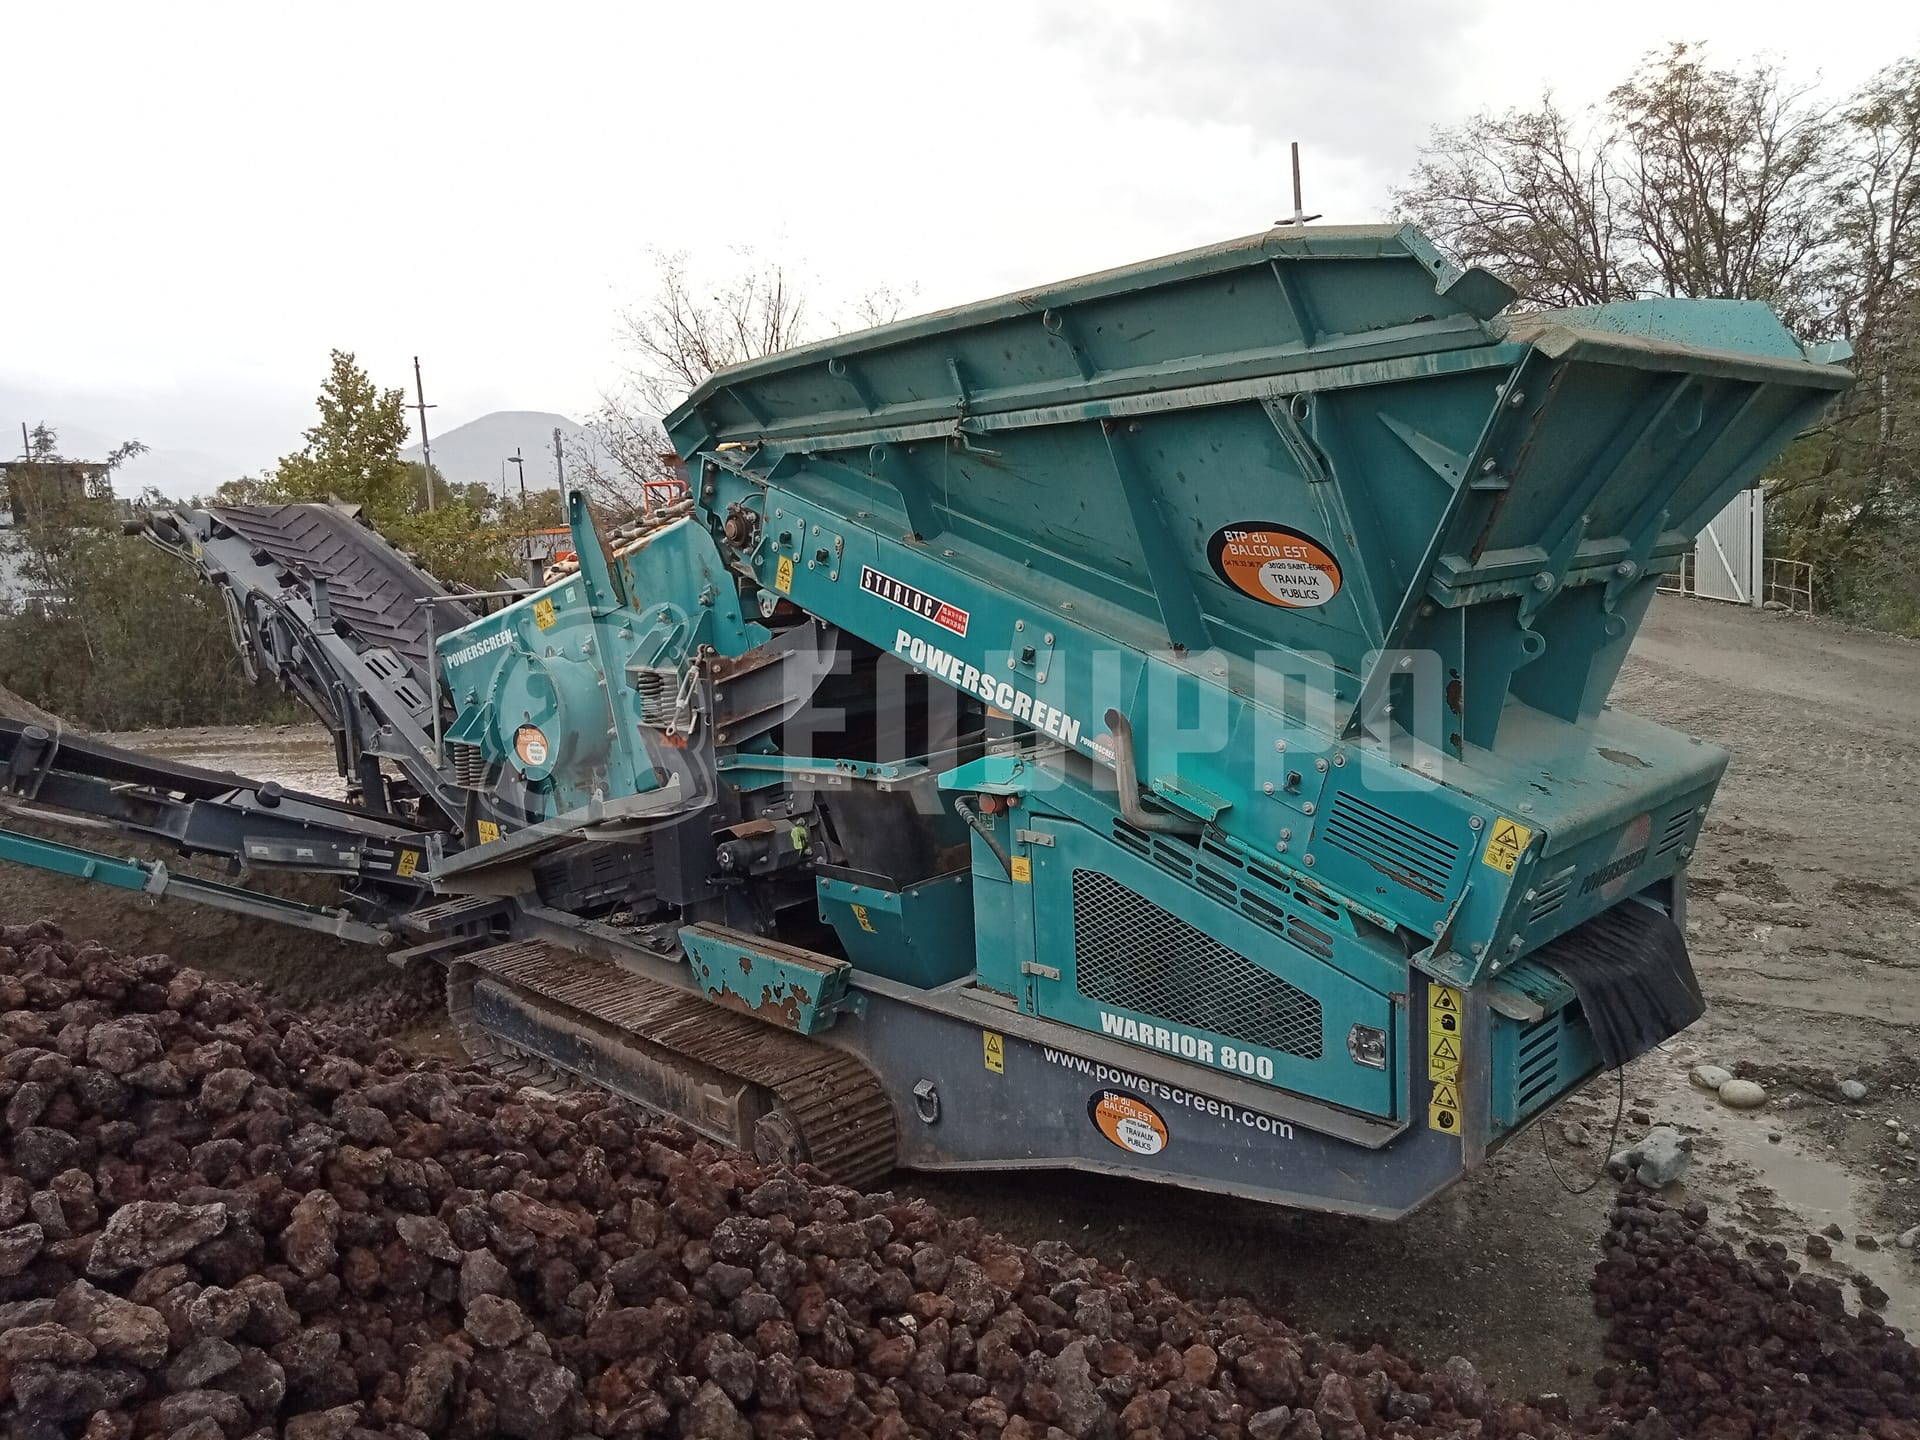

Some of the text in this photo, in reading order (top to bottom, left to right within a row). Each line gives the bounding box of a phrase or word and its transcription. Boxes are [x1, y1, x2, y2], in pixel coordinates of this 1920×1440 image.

[1224, 530, 1268, 543] BTP du
[1229, 543, 1308, 558] BALCON EST
[1271, 574, 1320, 586] TRAVAUX
[864, 570, 933, 617] STARLOC
[1280, 588, 1320, 600] PUBLICS
[446, 628, 513, 670] POWERSCREEN
[895, 628, 1081, 745] POWERSCREEN
[1080, 736, 1116, 760] POWERSCREE
[1100, 1011, 1274, 1081] WARRIOR 800
[1044, 1047, 1294, 1140] www.powerscreen.com
[1103, 1091, 1119, 1101] BTP
[1104, 1100, 1136, 1117] BALCON
[1138, 1111, 1153, 1123] EST
[1125, 1126, 1154, 1142] TRAVAUX
